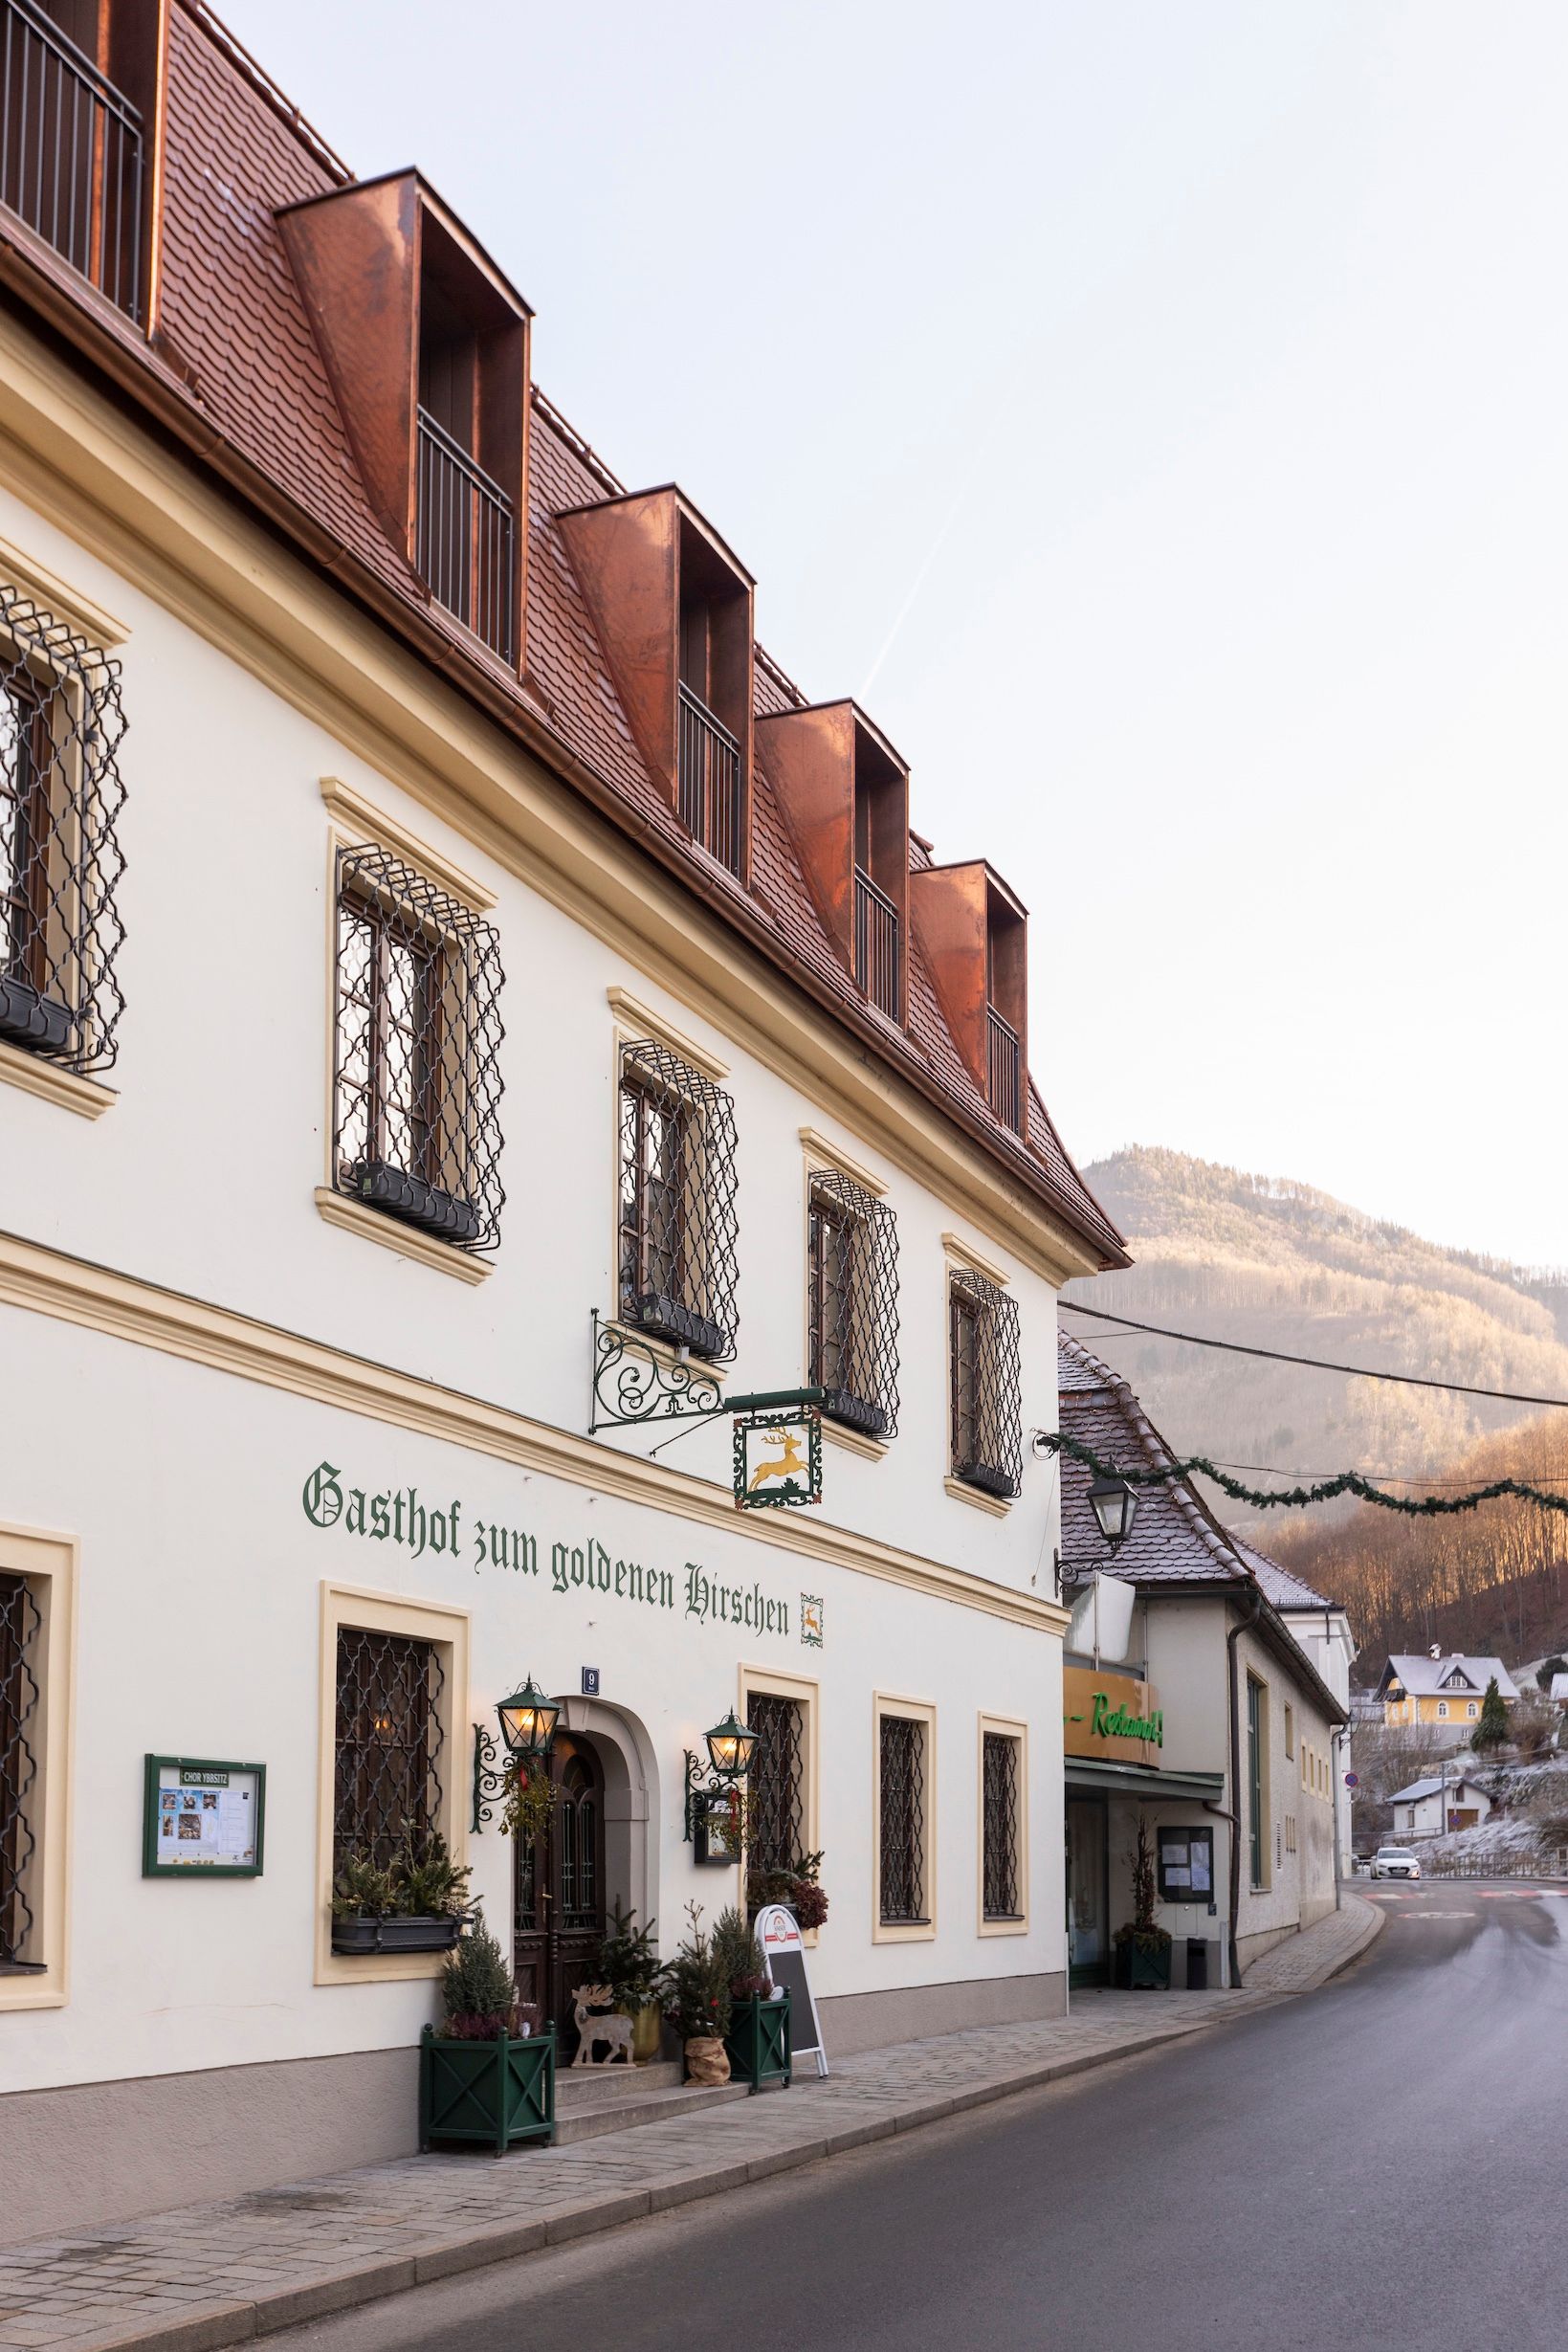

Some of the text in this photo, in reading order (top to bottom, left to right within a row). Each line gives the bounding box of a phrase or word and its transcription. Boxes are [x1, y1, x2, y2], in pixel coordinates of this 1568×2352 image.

[302, 1460, 789, 1637] Gasthof zum goldenen Hirschen
[588, 1673, 595, 1685] 9
[184, 1771, 201, 1782] CHOR
